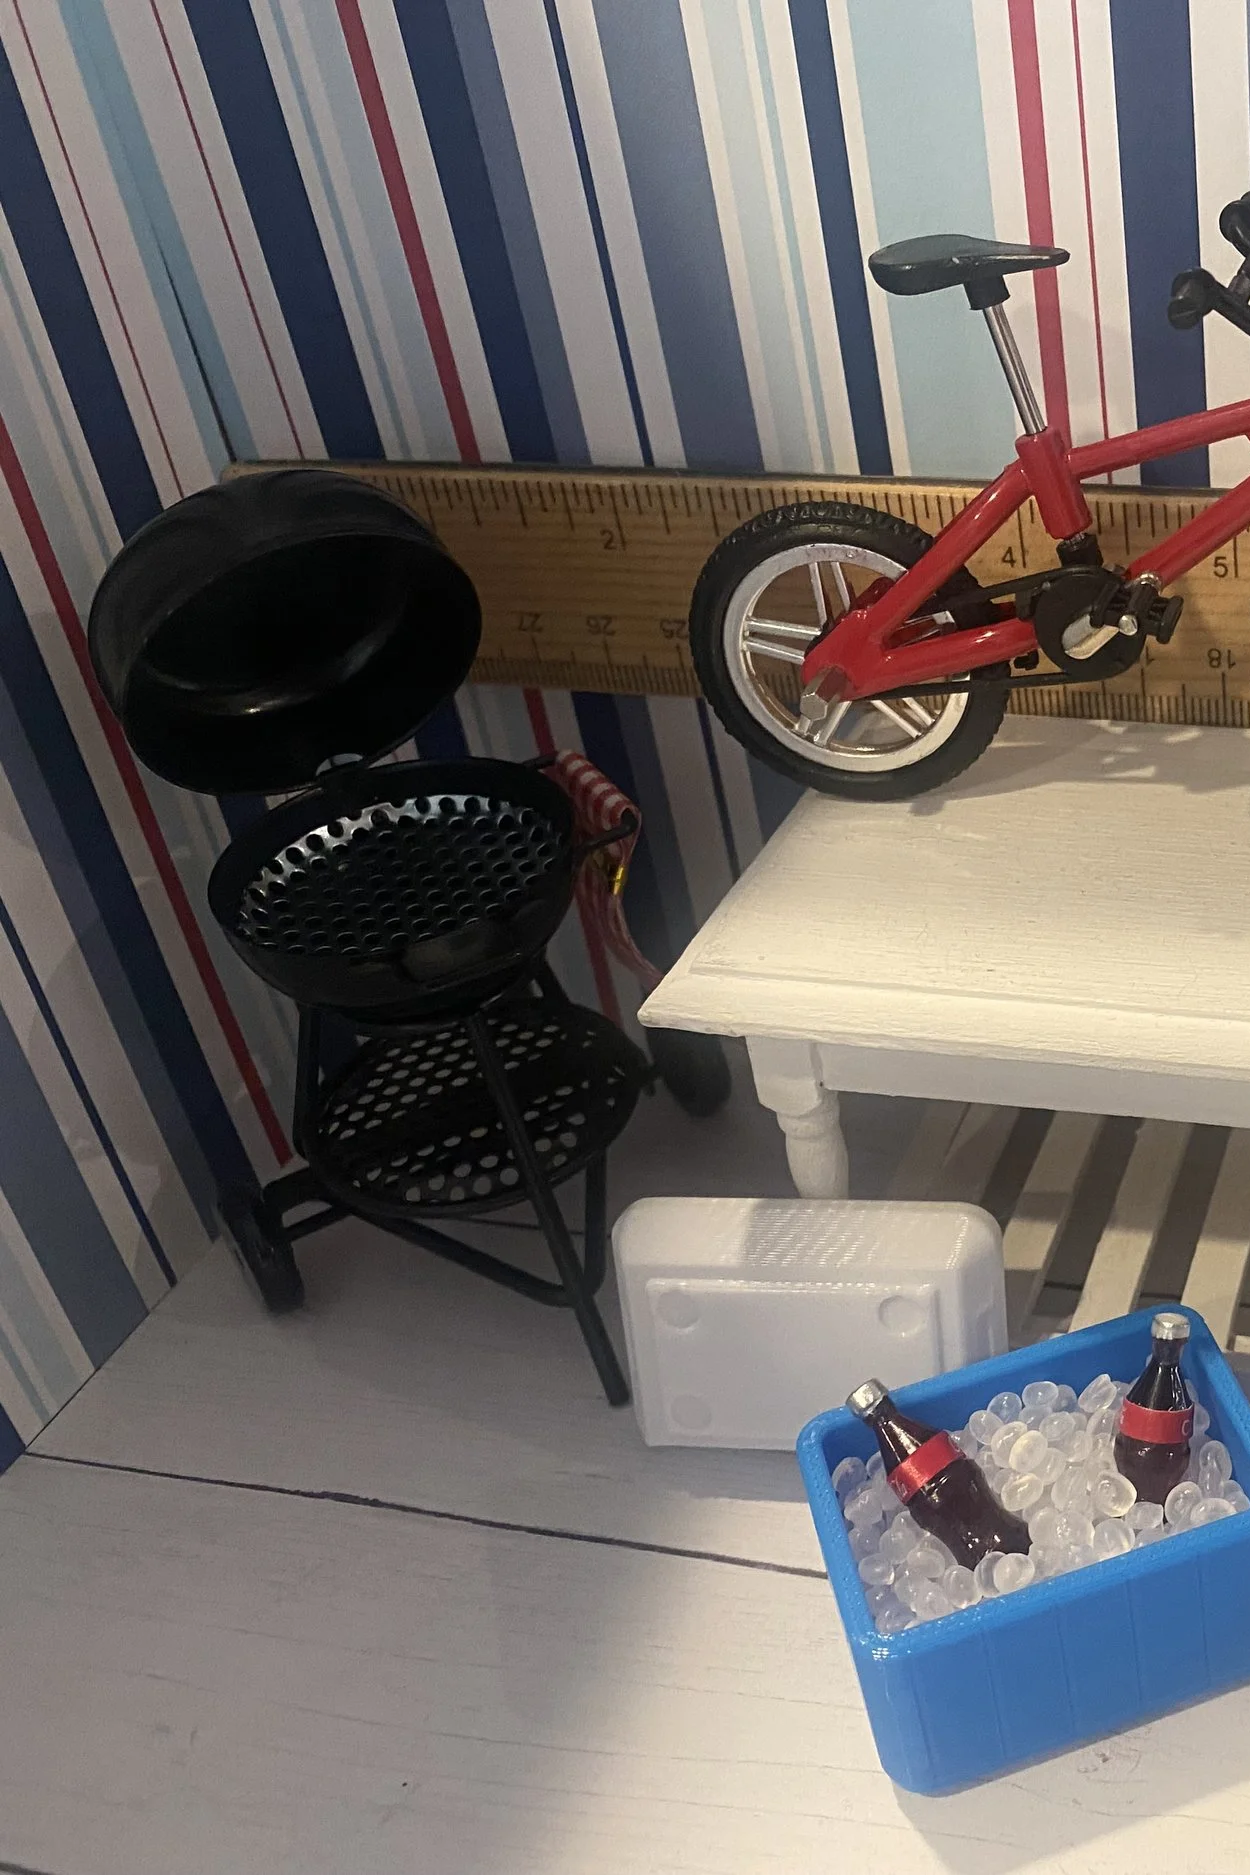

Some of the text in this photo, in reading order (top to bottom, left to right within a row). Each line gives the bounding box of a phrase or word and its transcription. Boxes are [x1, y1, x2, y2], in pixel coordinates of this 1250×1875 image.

[600, 530, 617, 550] 2
[1002, 546, 1017, 568] 4
[1213, 556, 1229, 578] 5
[517, 611, 544, 633] 27
[586, 615, 617, 637] 26
[659, 618, 690, 640] 25
[1206, 648, 1237, 670] 18
